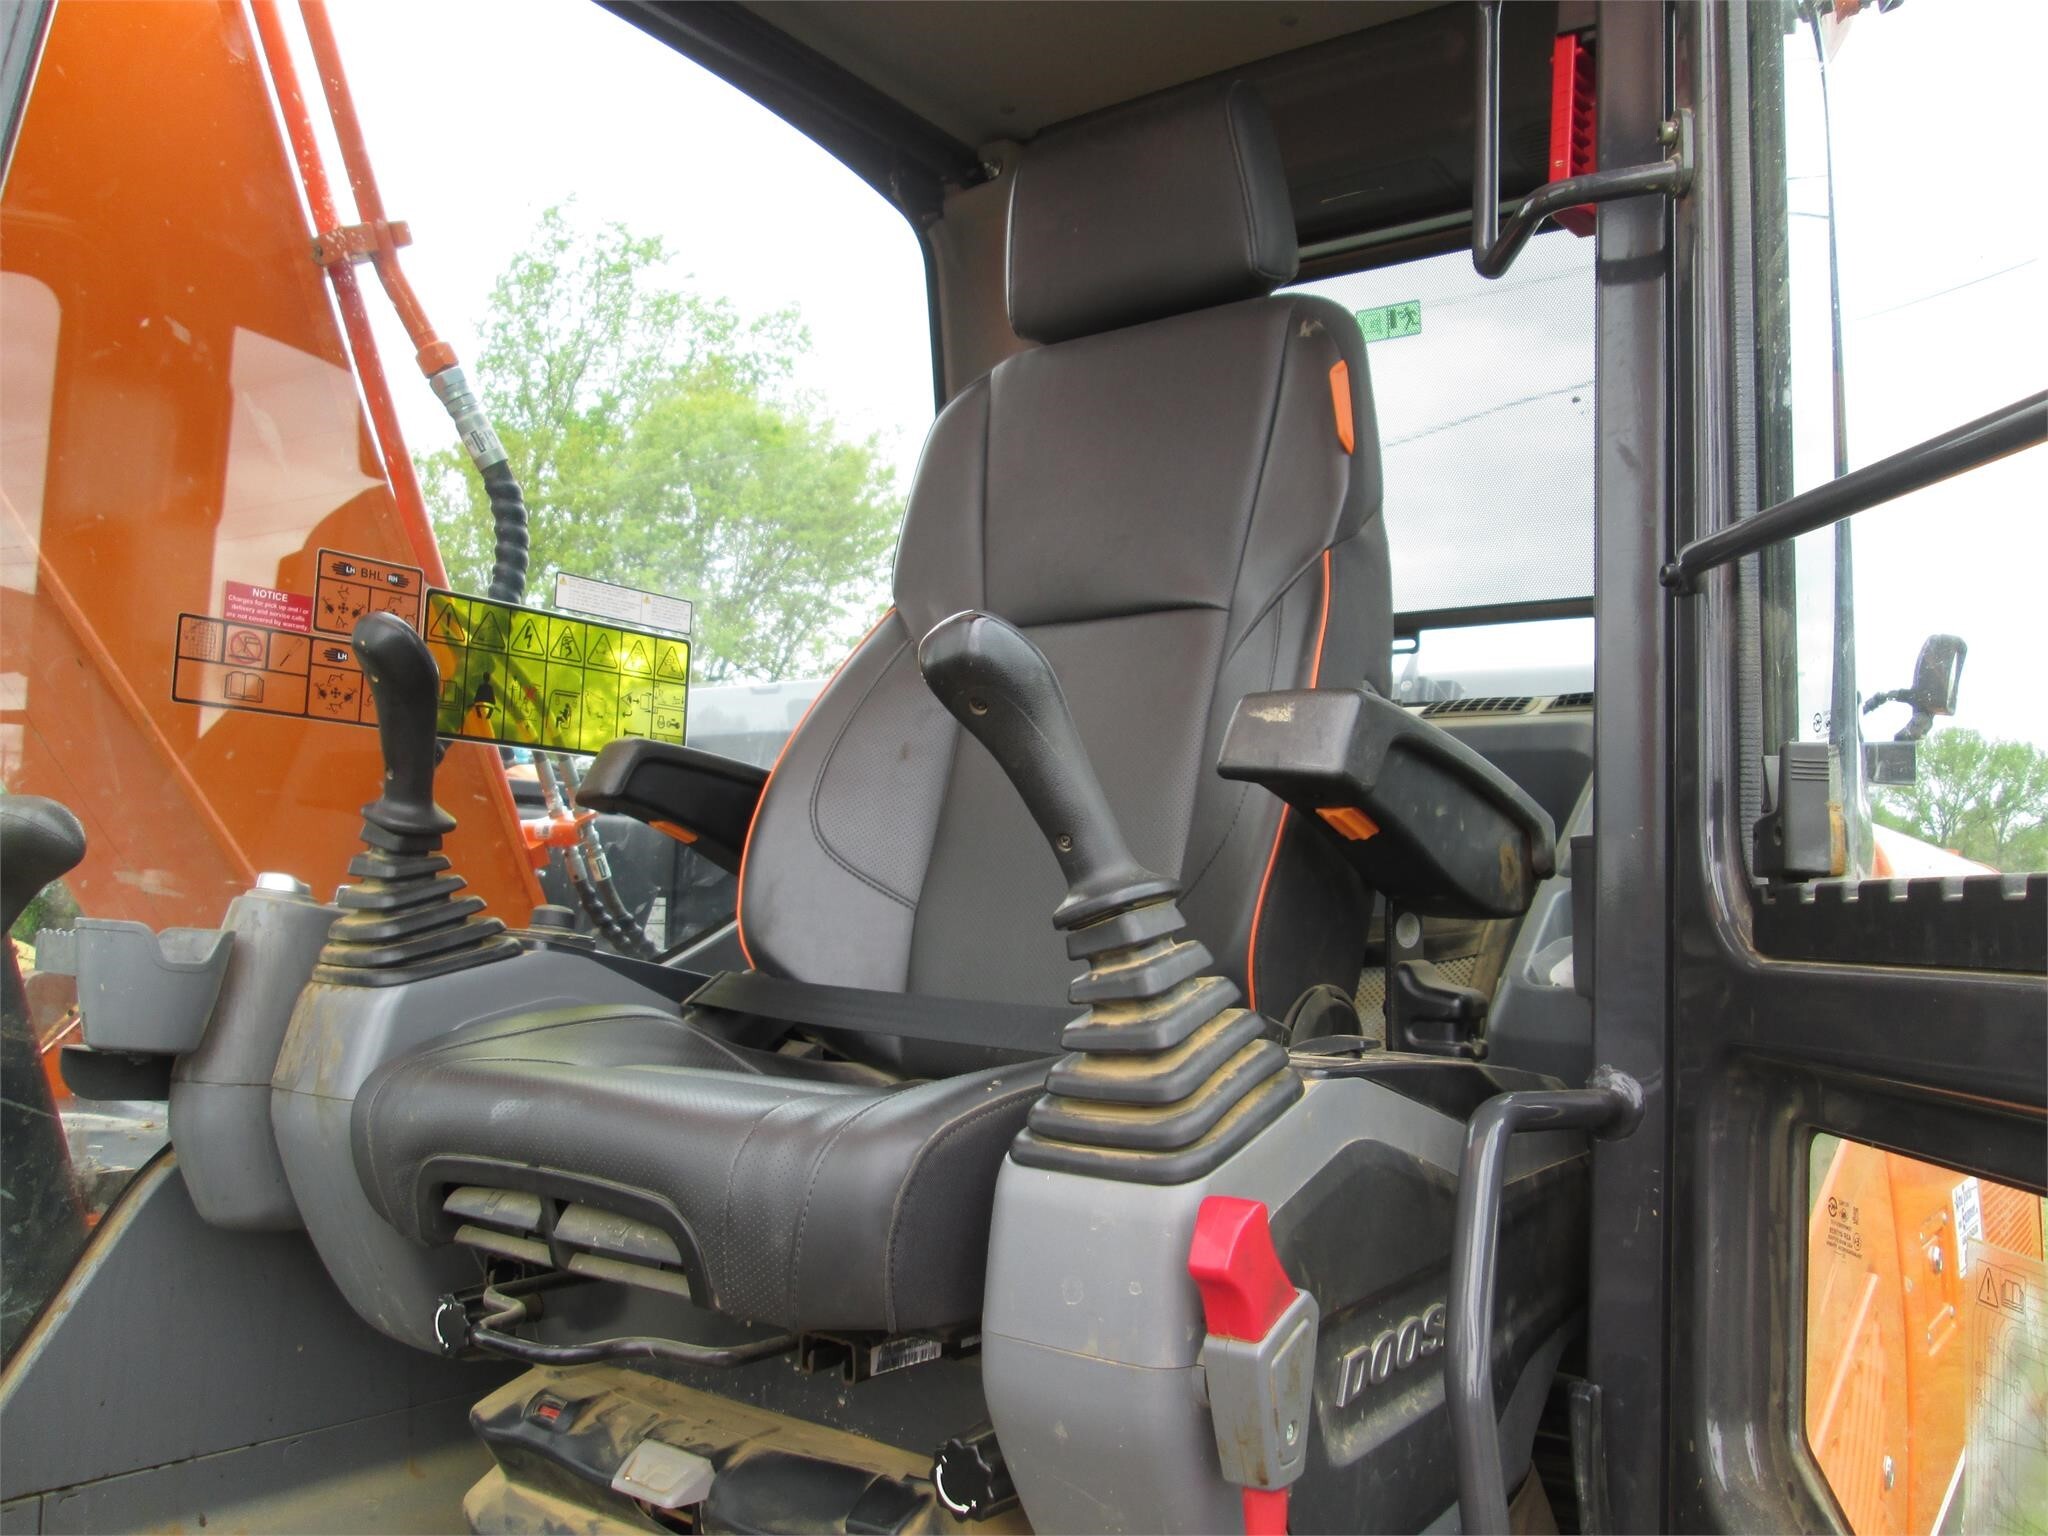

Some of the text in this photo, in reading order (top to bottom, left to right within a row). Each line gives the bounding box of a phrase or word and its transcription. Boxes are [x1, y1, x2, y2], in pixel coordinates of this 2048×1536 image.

[361, 567, 384, 582] BHL
[228, 594, 254, 605] Charges
[252, 588, 288, 602] NOTICE
[231, 603, 255, 614] delivery
[270, 611, 291, 620] service
[291, 614, 305, 622] calls
[248, 615, 273, 624] covered
[274, 618, 282, 627] by
